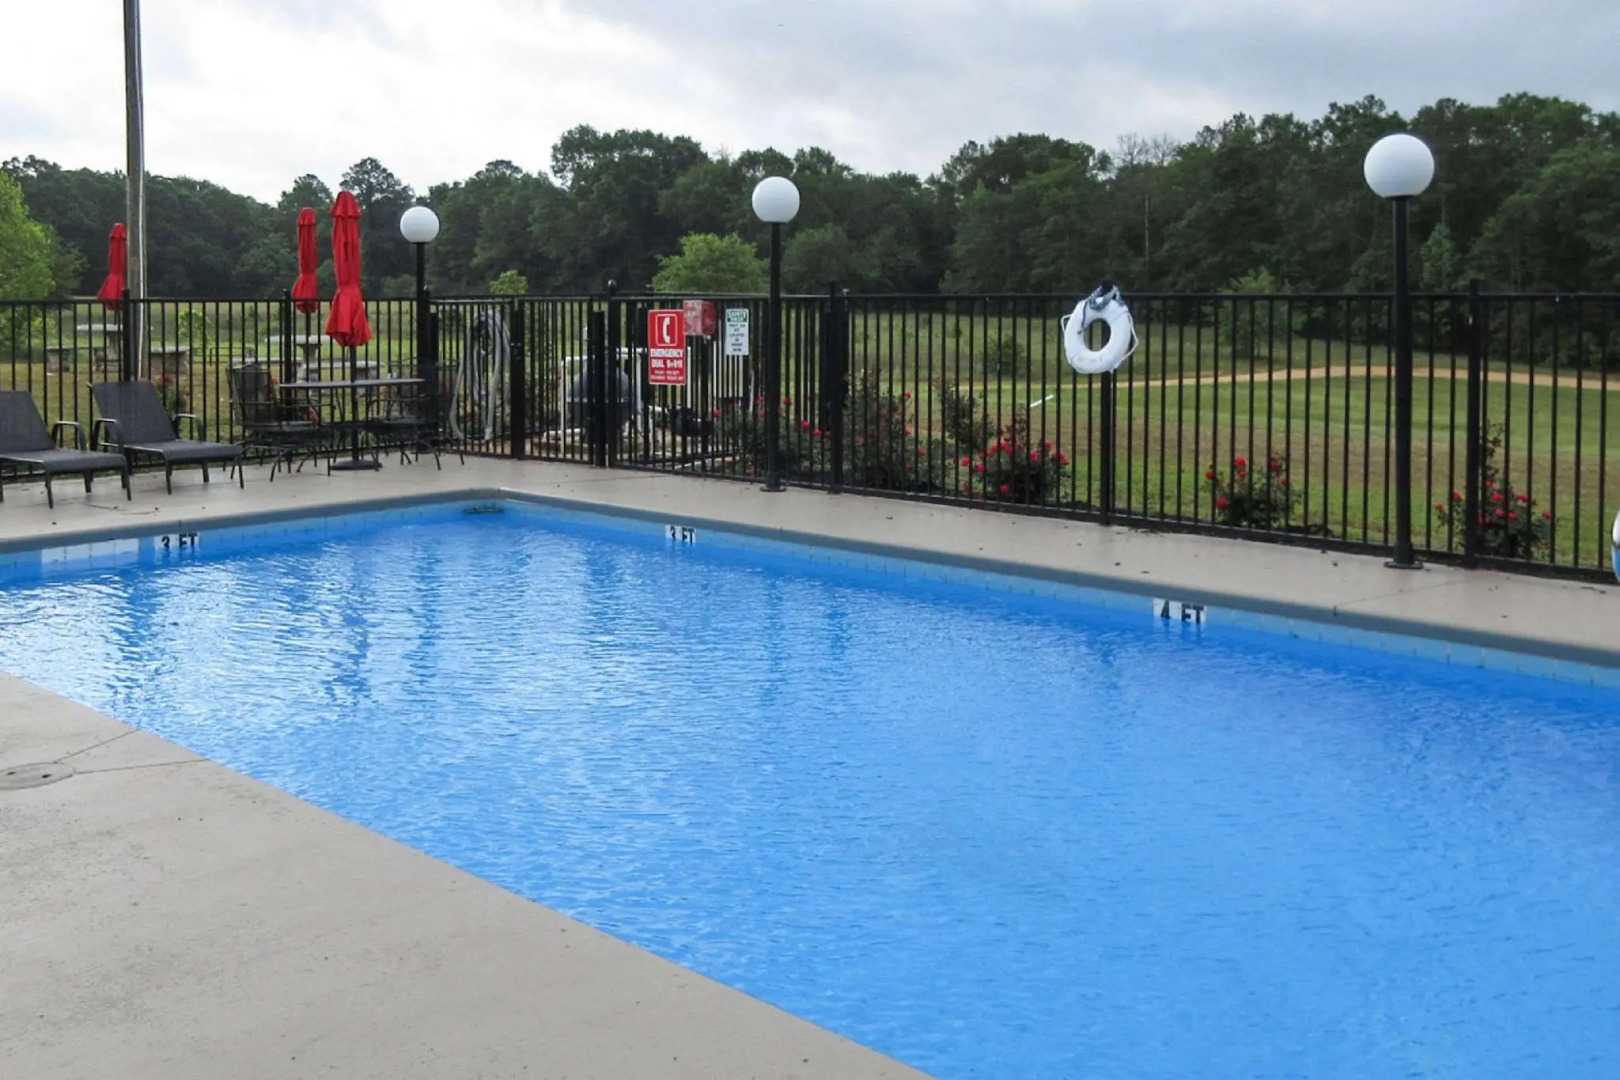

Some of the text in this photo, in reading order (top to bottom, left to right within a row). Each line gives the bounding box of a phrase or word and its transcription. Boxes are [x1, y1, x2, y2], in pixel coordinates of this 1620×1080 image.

[651, 359, 666, 368] DIAL
[179, 533, 198, 548] FT
[681, 526, 695, 544] FT
[1160, 600, 1204, 624] 4 FT
